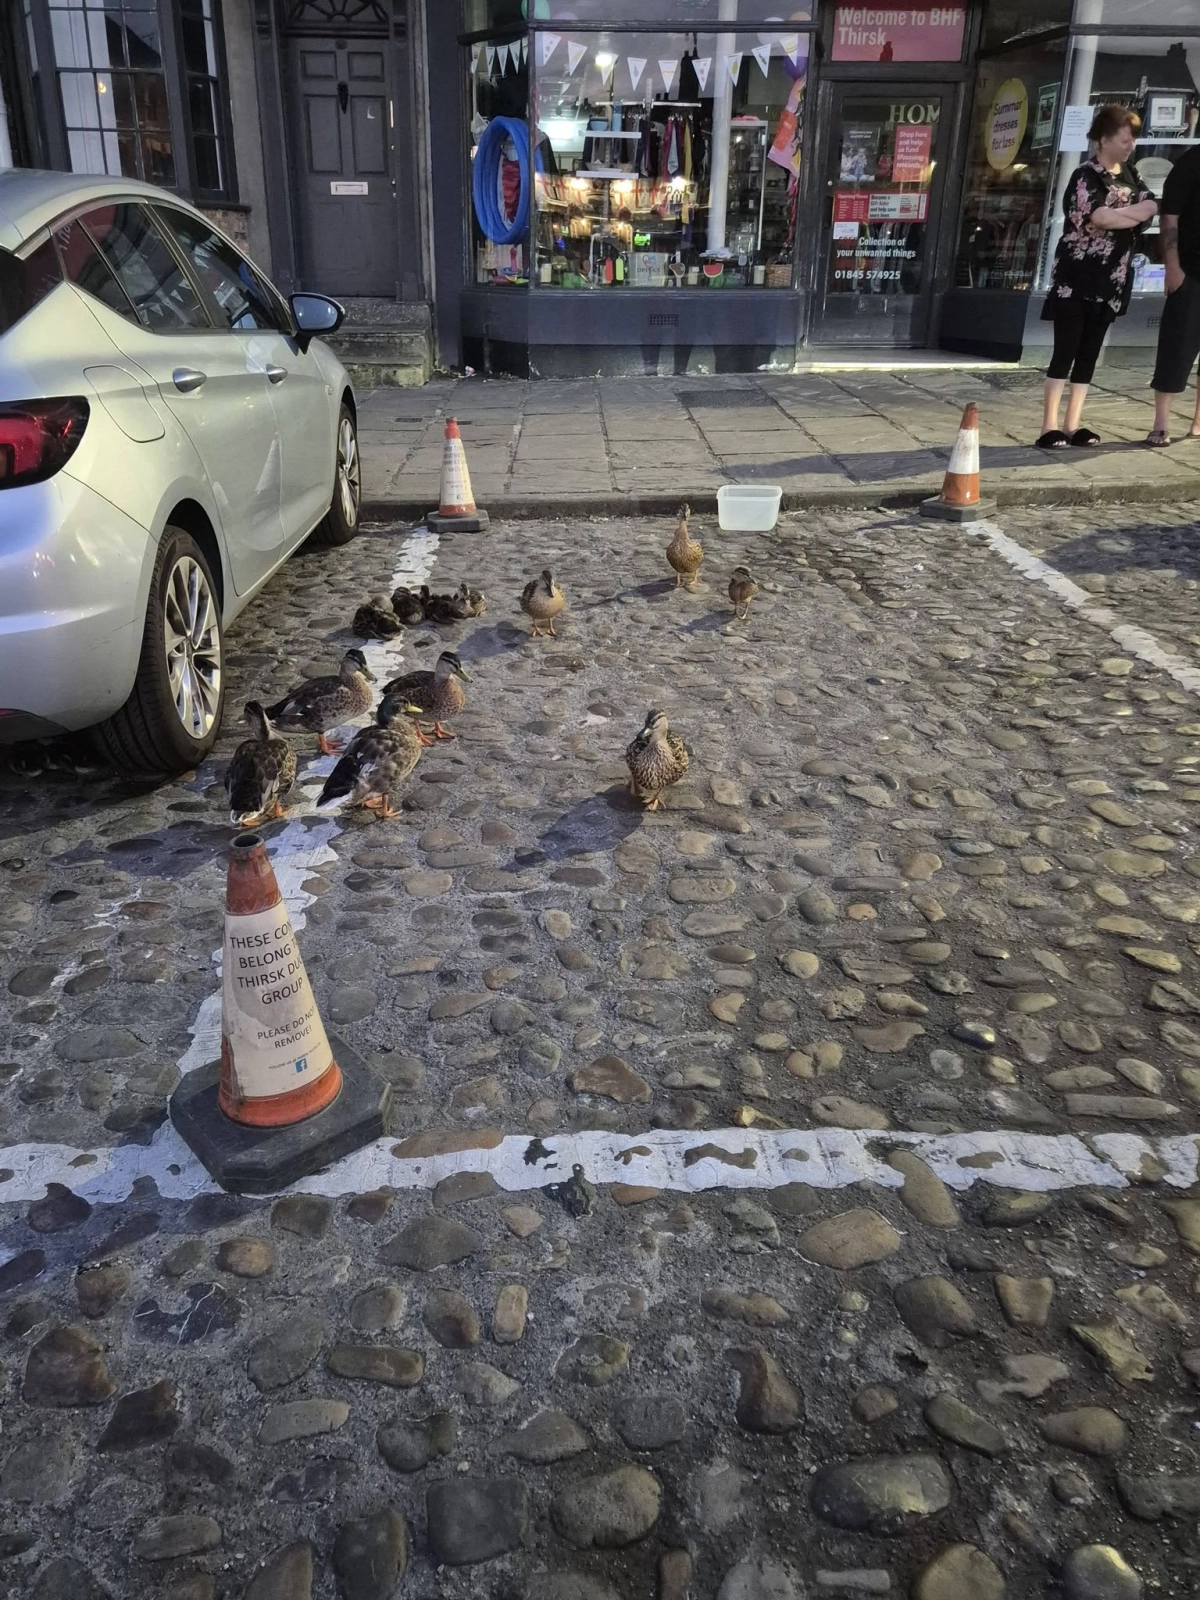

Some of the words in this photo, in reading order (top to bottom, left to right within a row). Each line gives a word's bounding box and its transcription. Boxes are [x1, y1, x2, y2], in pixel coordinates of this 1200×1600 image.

[839, 7, 907, 26] Welcome
[911, 10, 926, 26] to
[930, 8, 963, 26] BHF
[839, 27, 886, 46] Thirsk
[994, 101, 1023, 116] Summer
[993, 119, 1018, 133] dresses
[911, 139, 924, 147] help
[992, 138, 1002, 150] for
[1003, 136, 1015, 148] less
[859, 237, 896, 246] Collection
[897, 237, 906, 246] of
[836, 249, 854, 258] your
[855, 249, 892, 257] unwanted
[892, 249, 916, 259] things
[834, 270, 864, 279] 01845
[865, 270, 901, 279] 574925
[229, 932, 271, 949] THESE
[238, 943, 292, 969] BELONG
[237, 967, 286, 989] THIRSK
[261, 977, 303, 1005] GROUP
[257, 1023, 292, 1040] PLEASE
[292, 1016, 305, 1029] DO
[274, 1024, 313, 1049] REMOVE!
